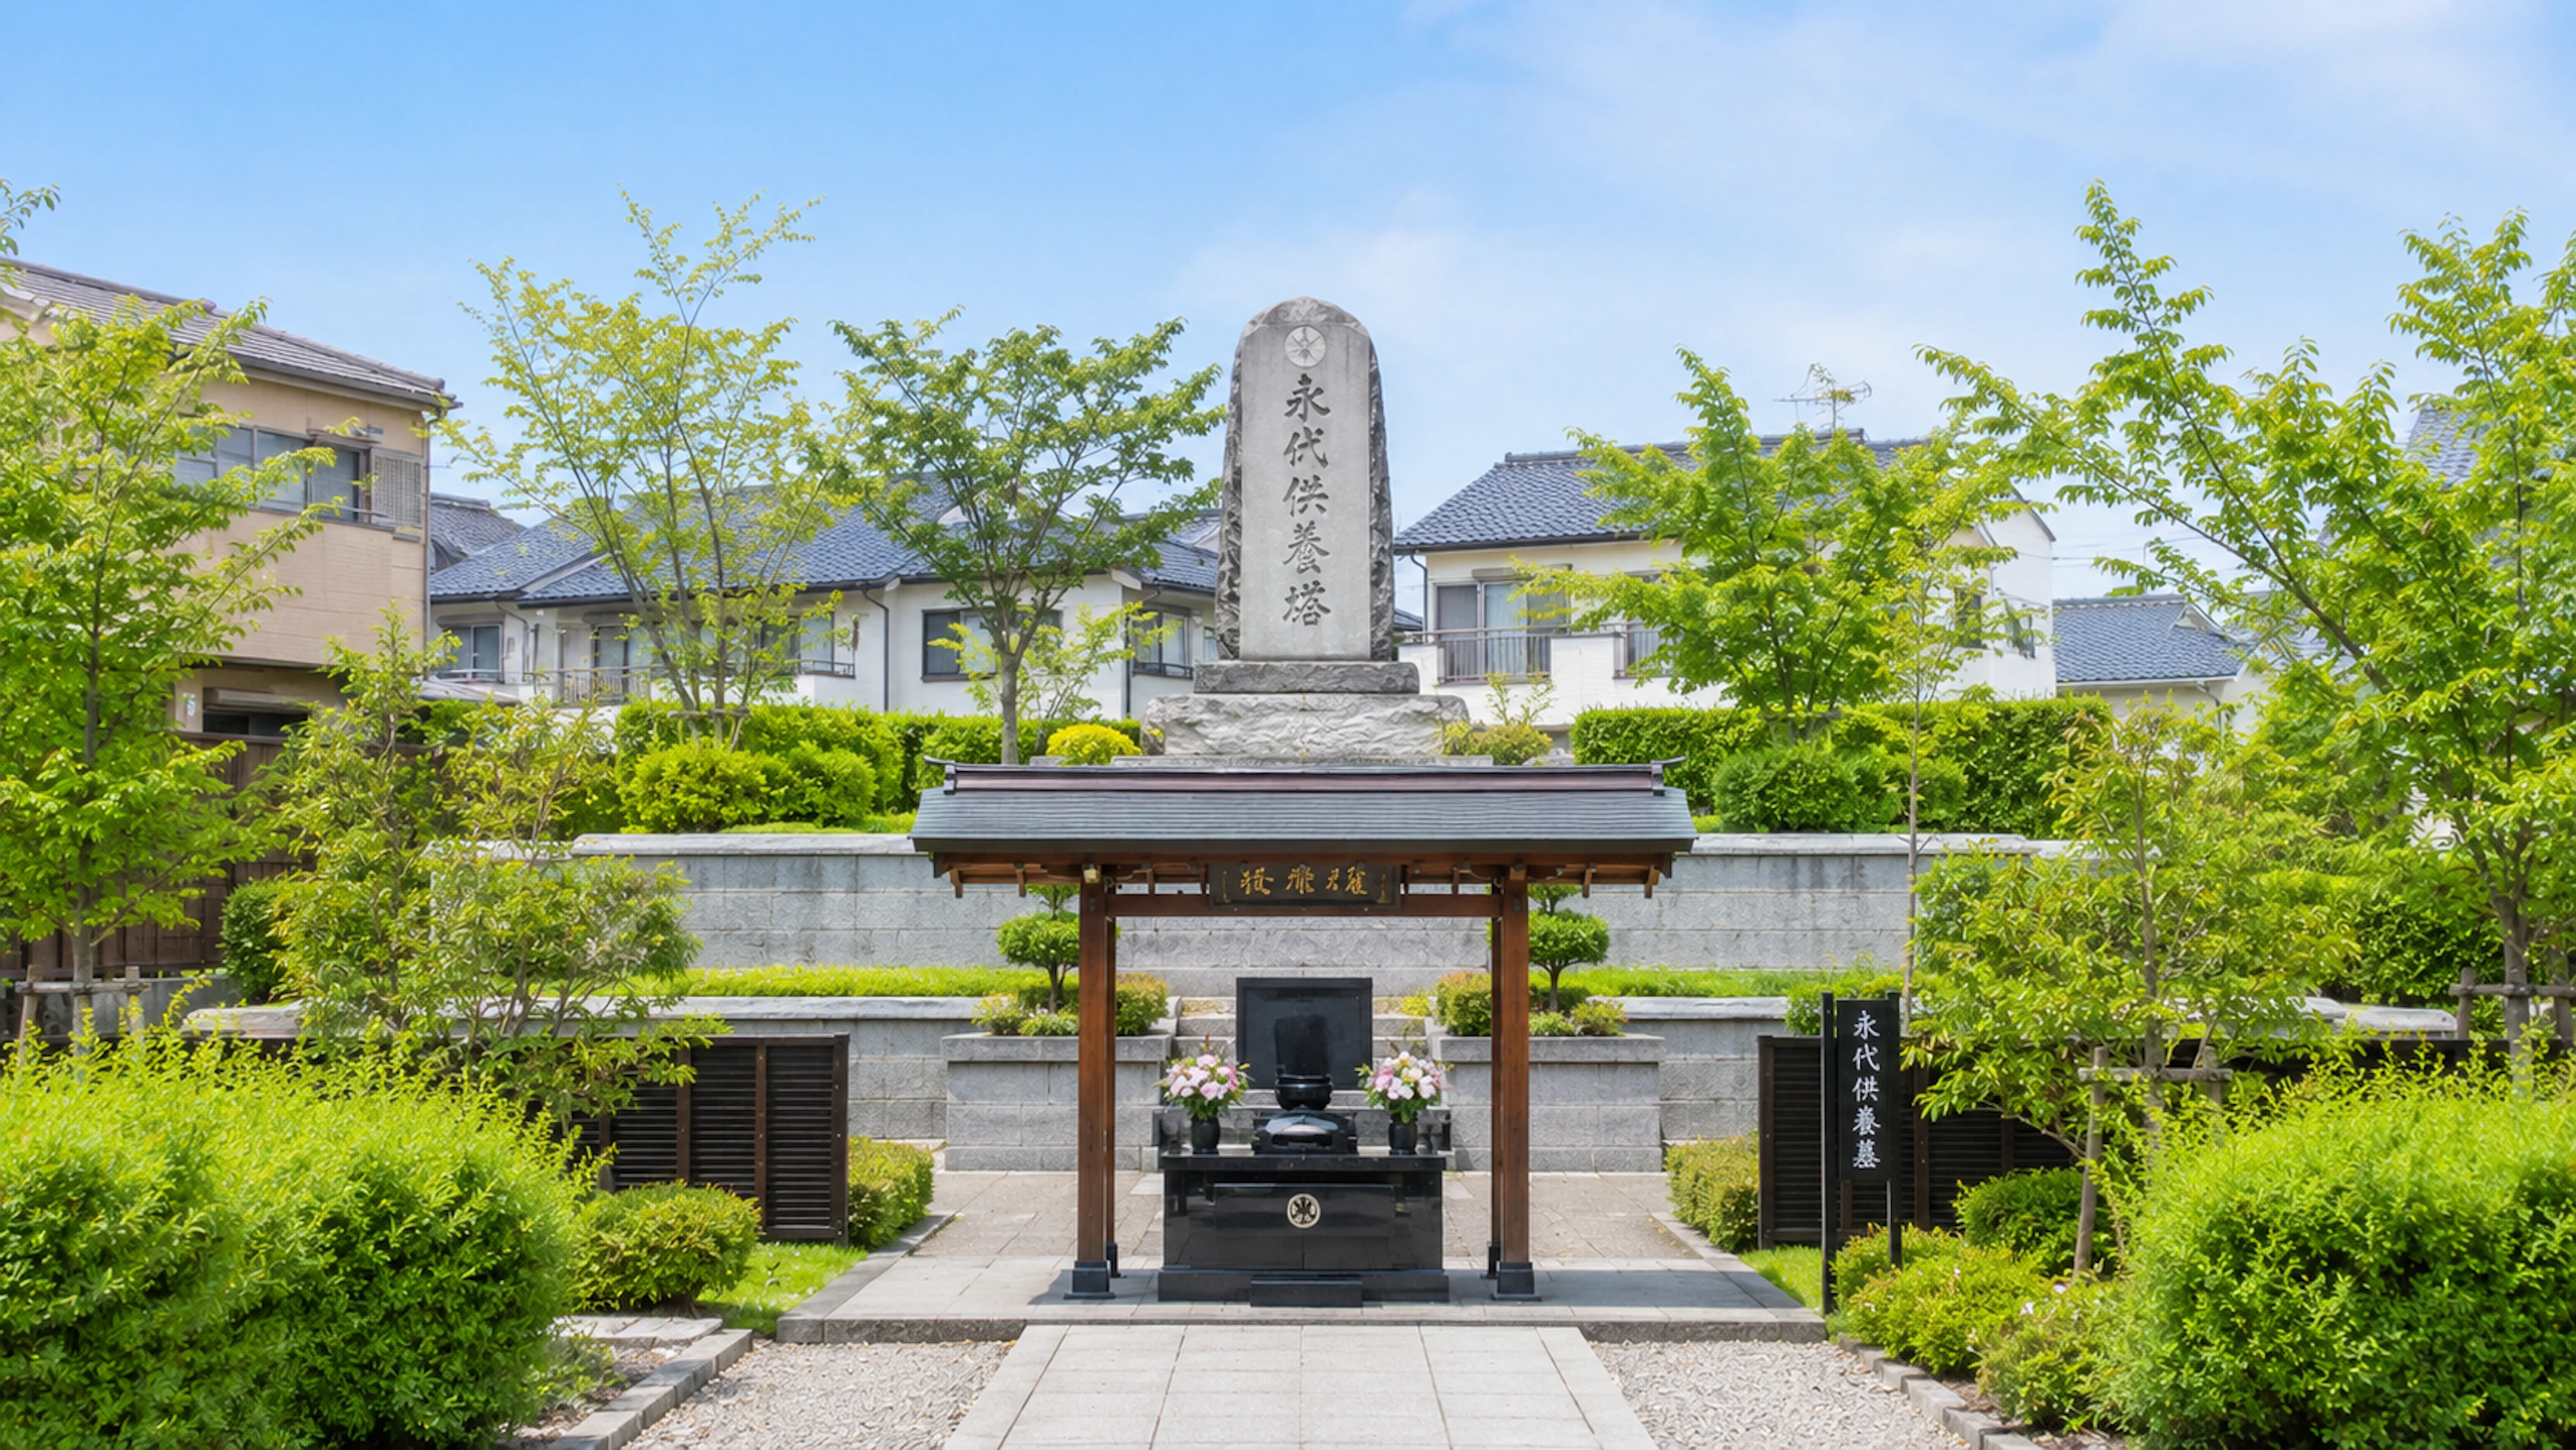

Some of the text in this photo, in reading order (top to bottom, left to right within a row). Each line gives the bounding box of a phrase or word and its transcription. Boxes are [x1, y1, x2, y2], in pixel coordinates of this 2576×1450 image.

[1283, 373, 1332, 626] 永代供養塔
[1852, 1009, 1881, 1170] 永代供養墓
